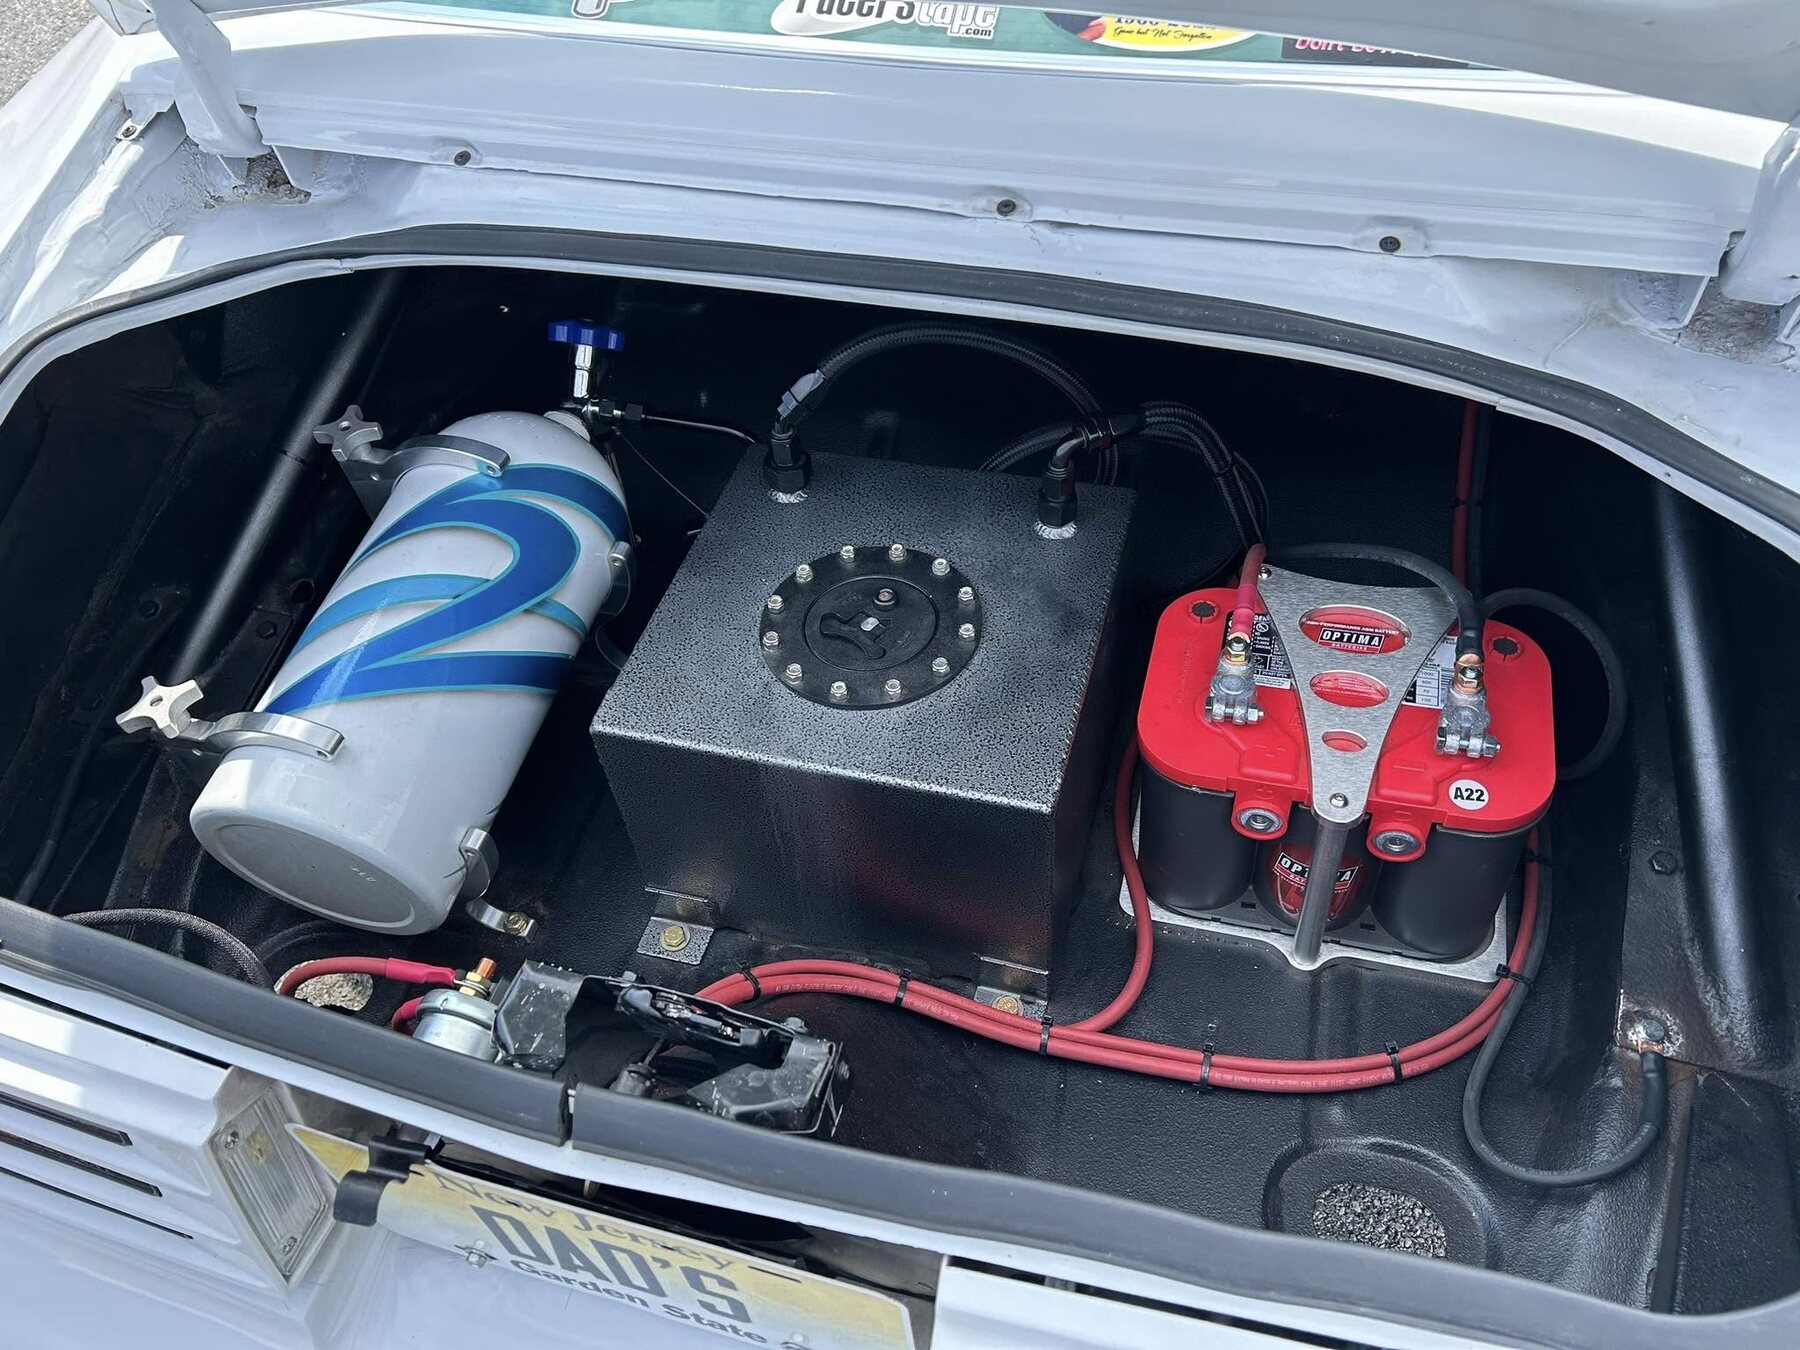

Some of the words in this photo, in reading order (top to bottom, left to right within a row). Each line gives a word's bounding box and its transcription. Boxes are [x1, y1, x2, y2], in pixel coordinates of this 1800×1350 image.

[962, 28, 992, 37] .com
[1113, 27, 1135, 38] Gone
[1136, 27, 1150, 35] but
[1153, 29, 1172, 38] Not
[1173, 30, 1213, 41] Forgotten
[1322, 629, 1380, 647] OPTIMA
[1453, 786, 1486, 802] A22
[433, 1172, 556, 1218] New
[571, 1213, 735, 1269] Jersey
[470, 1204, 752, 1324] DAD'S
[510, 1259, 649, 1308] Garden
[662, 1303, 768, 1344] State
